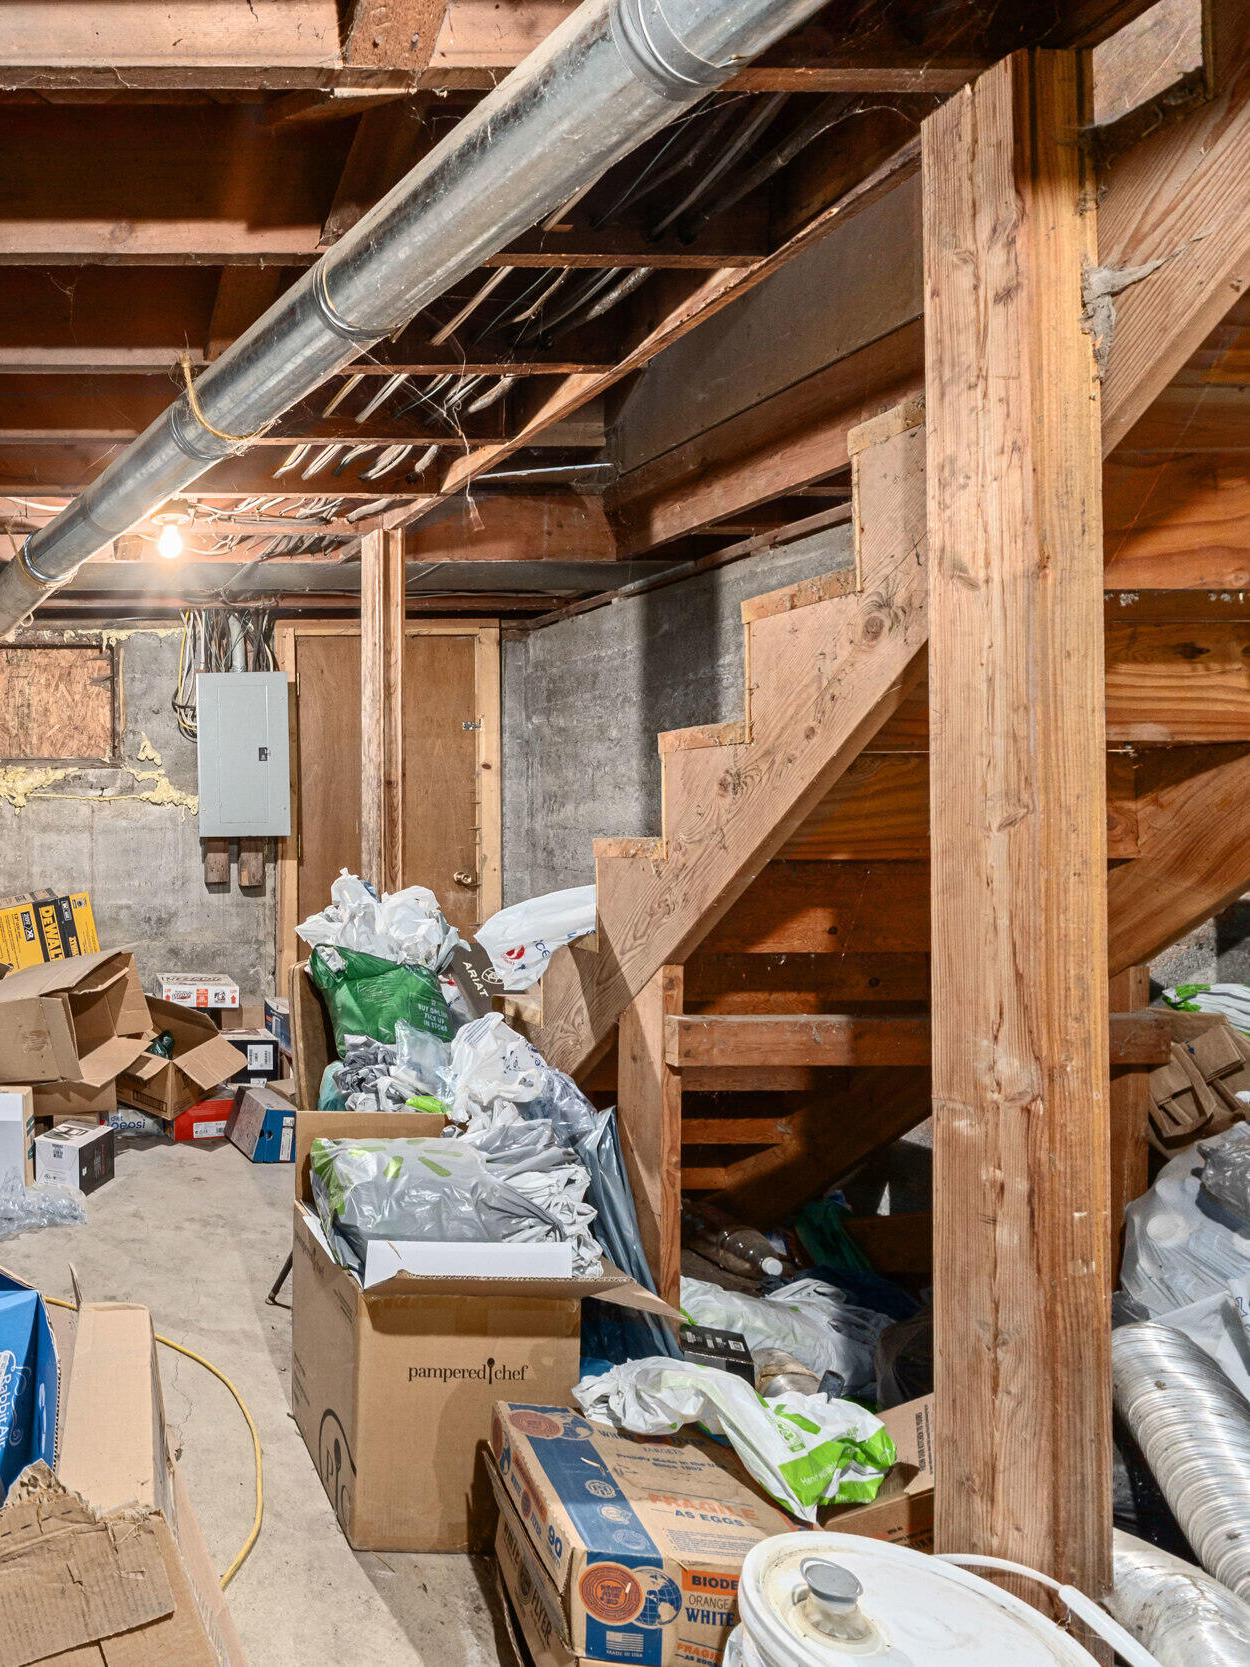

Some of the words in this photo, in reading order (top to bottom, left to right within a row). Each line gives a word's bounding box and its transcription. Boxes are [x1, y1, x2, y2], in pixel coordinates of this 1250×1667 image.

[463, 961, 489, 997] ARIAT
[408, 1364, 487, 1383] pampered
[494, 1364, 529, 1381] chef
[652, 1456, 677, 1464] Made
[652, 1461, 677, 1470] Since
[647, 1493, 760, 1521] FRAGILE
[674, 1509, 695, 1519] AS
[698, 1513, 745, 1527] EGGS
[547, 1525, 563, 1559] 90
[688, 1594, 730, 1610] ORANGE
[685, 1607, 736, 1627] WHITE
[606, 1649, 623, 1657] MADE
